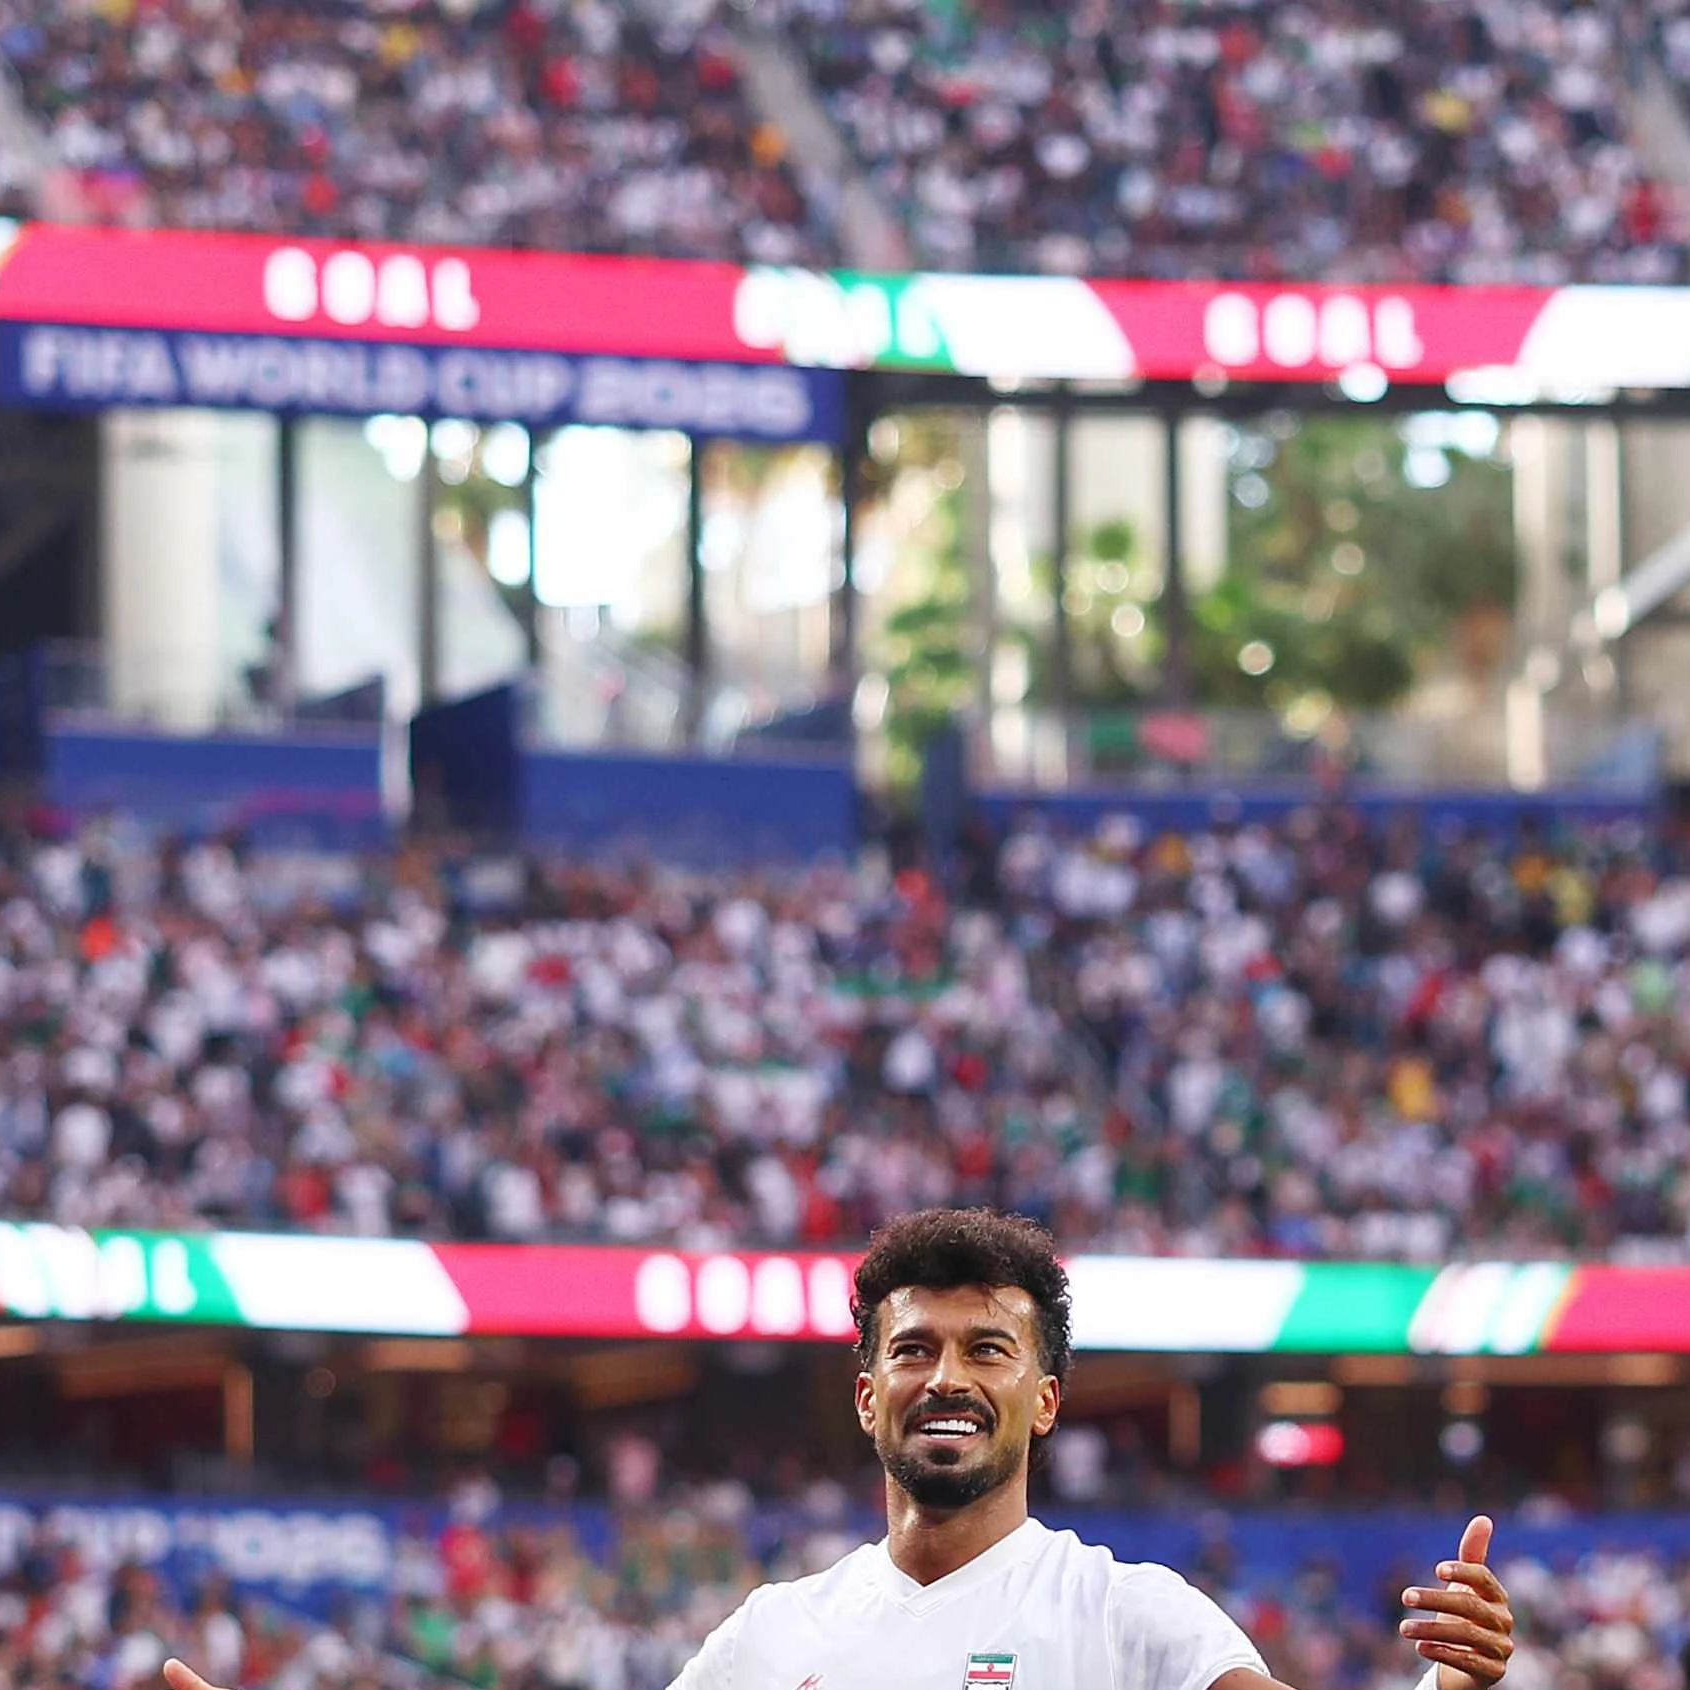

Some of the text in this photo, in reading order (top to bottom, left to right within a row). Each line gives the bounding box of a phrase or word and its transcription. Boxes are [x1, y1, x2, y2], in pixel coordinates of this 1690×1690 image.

[19, 327, 177, 400] FIFA
[181, 337, 429, 408] WORLD
[435, 347, 570, 420] CUP
